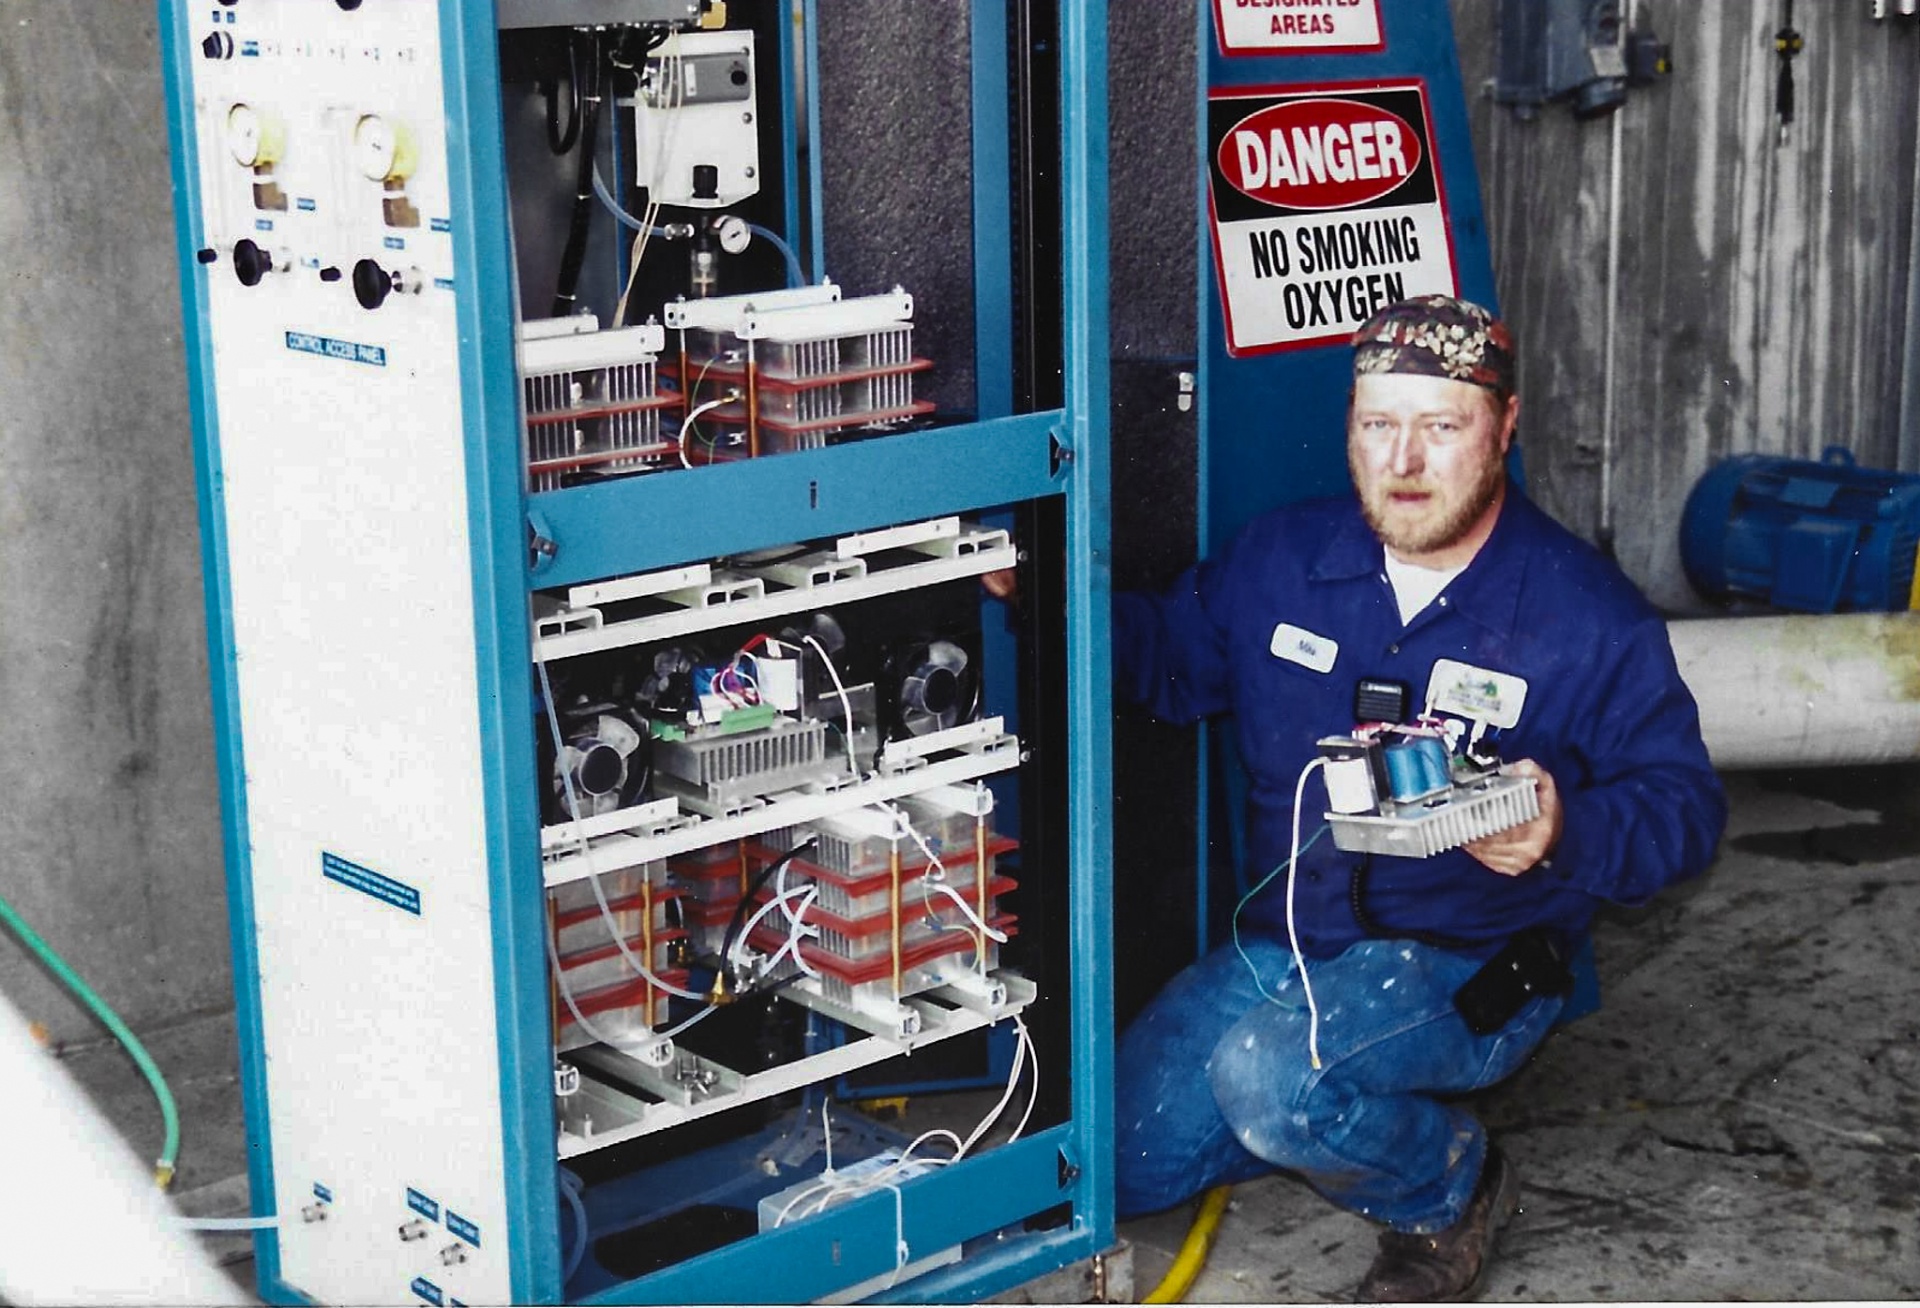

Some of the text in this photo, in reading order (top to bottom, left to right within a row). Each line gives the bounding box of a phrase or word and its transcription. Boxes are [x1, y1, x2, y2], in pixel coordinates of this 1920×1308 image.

[1271, 14, 1334, 34] AREAS
[1235, 121, 1407, 190] DANGER
[1249, 216, 1420, 279] NO SMOKING
[1283, 272, 1405, 329] OXYGEN
